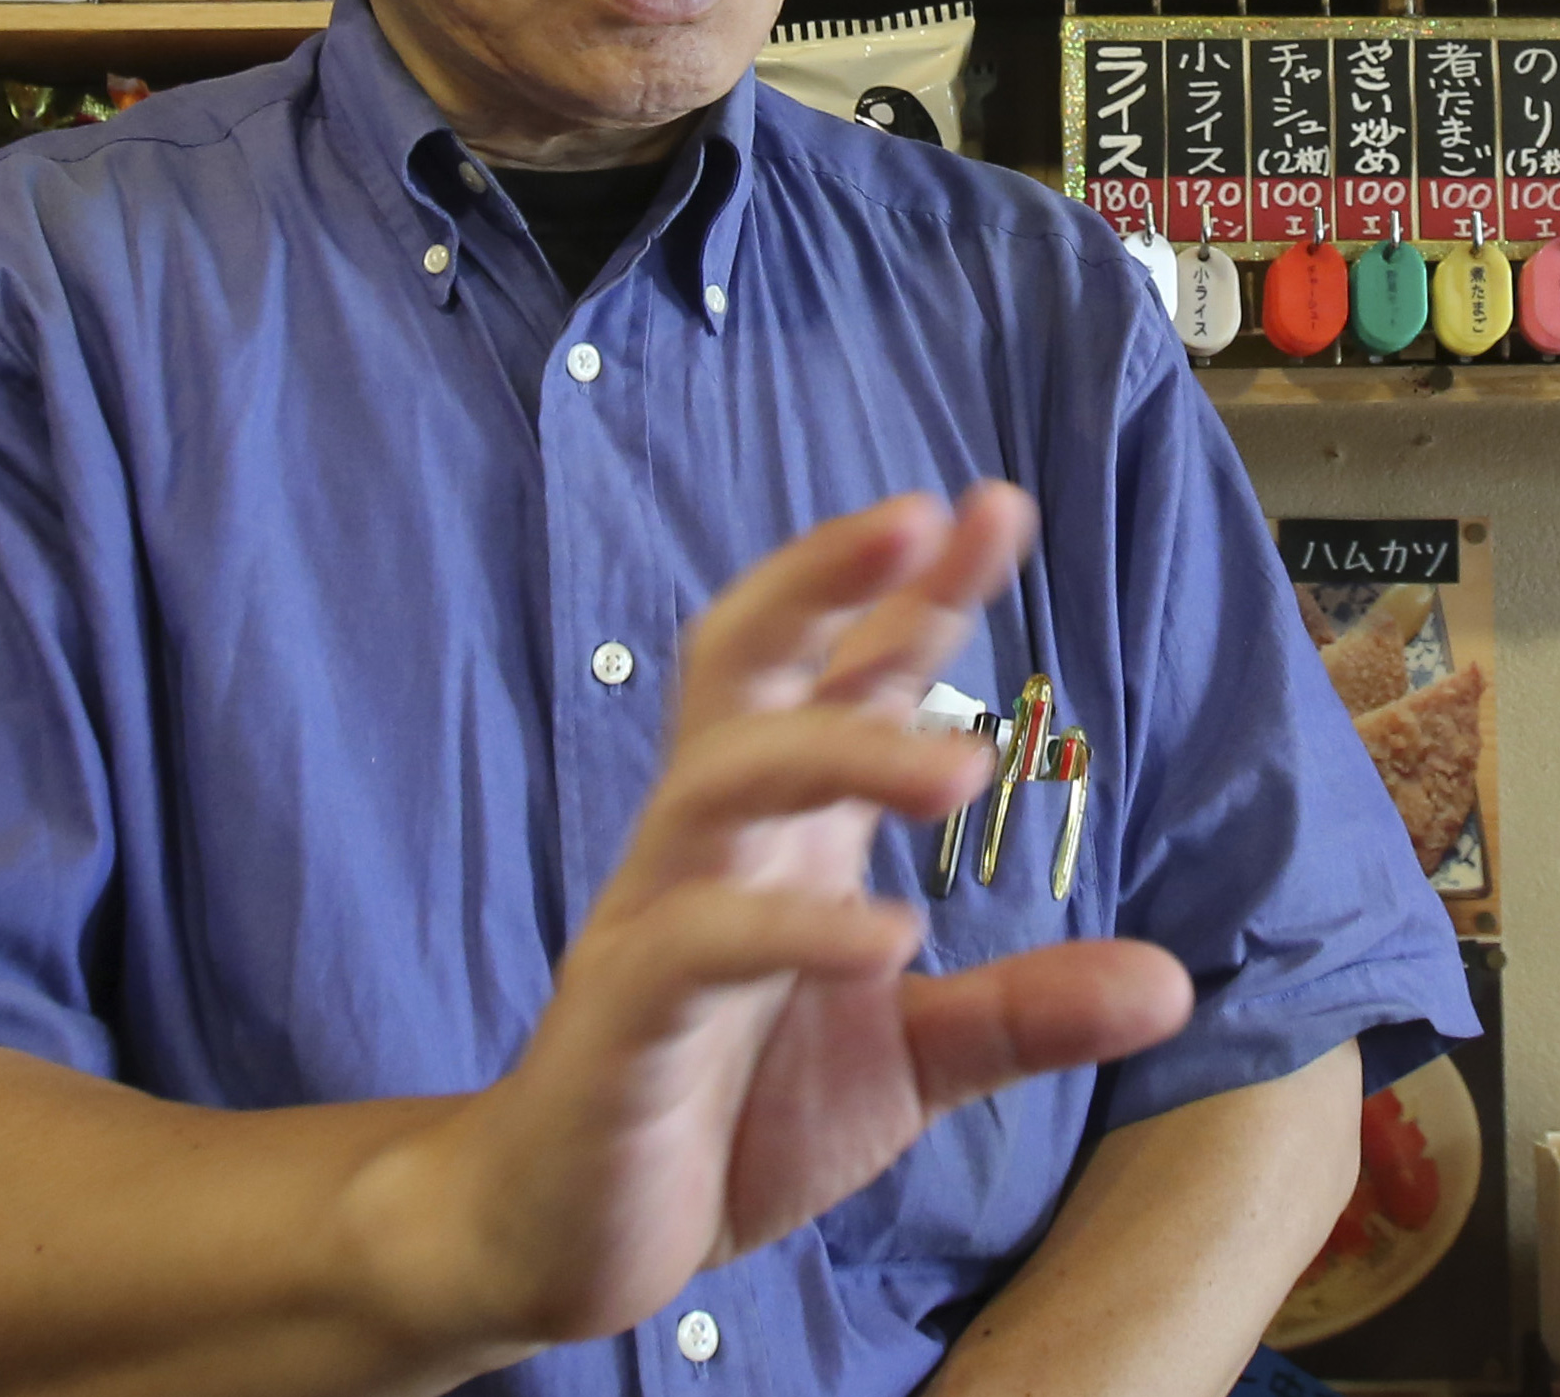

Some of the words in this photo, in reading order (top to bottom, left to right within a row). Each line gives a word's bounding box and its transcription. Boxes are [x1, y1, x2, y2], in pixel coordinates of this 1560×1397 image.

[1094, 44, 1148, 180] ライス
[1178, 42, 1229, 175] 小ライス
[1267, 42, 1328, 149] チャーシュー
[1347, 40, 1406, 177] やさい炒め
[1427, 42, 1493, 177] 煮たまご
[1513, 46, 1558, 149] のり
[1089, 181, 1151, 211] 180
[1258, 180, 1323, 208] 100
[1344, 180, 1407, 207] 100
[1428, 182, 1493, 210] 100
[1193, 267, 1210, 339] 小ライス
[1469, 265, 1488, 335] 煮たまご
[1299, 538, 1447, 580] ハムカツ
